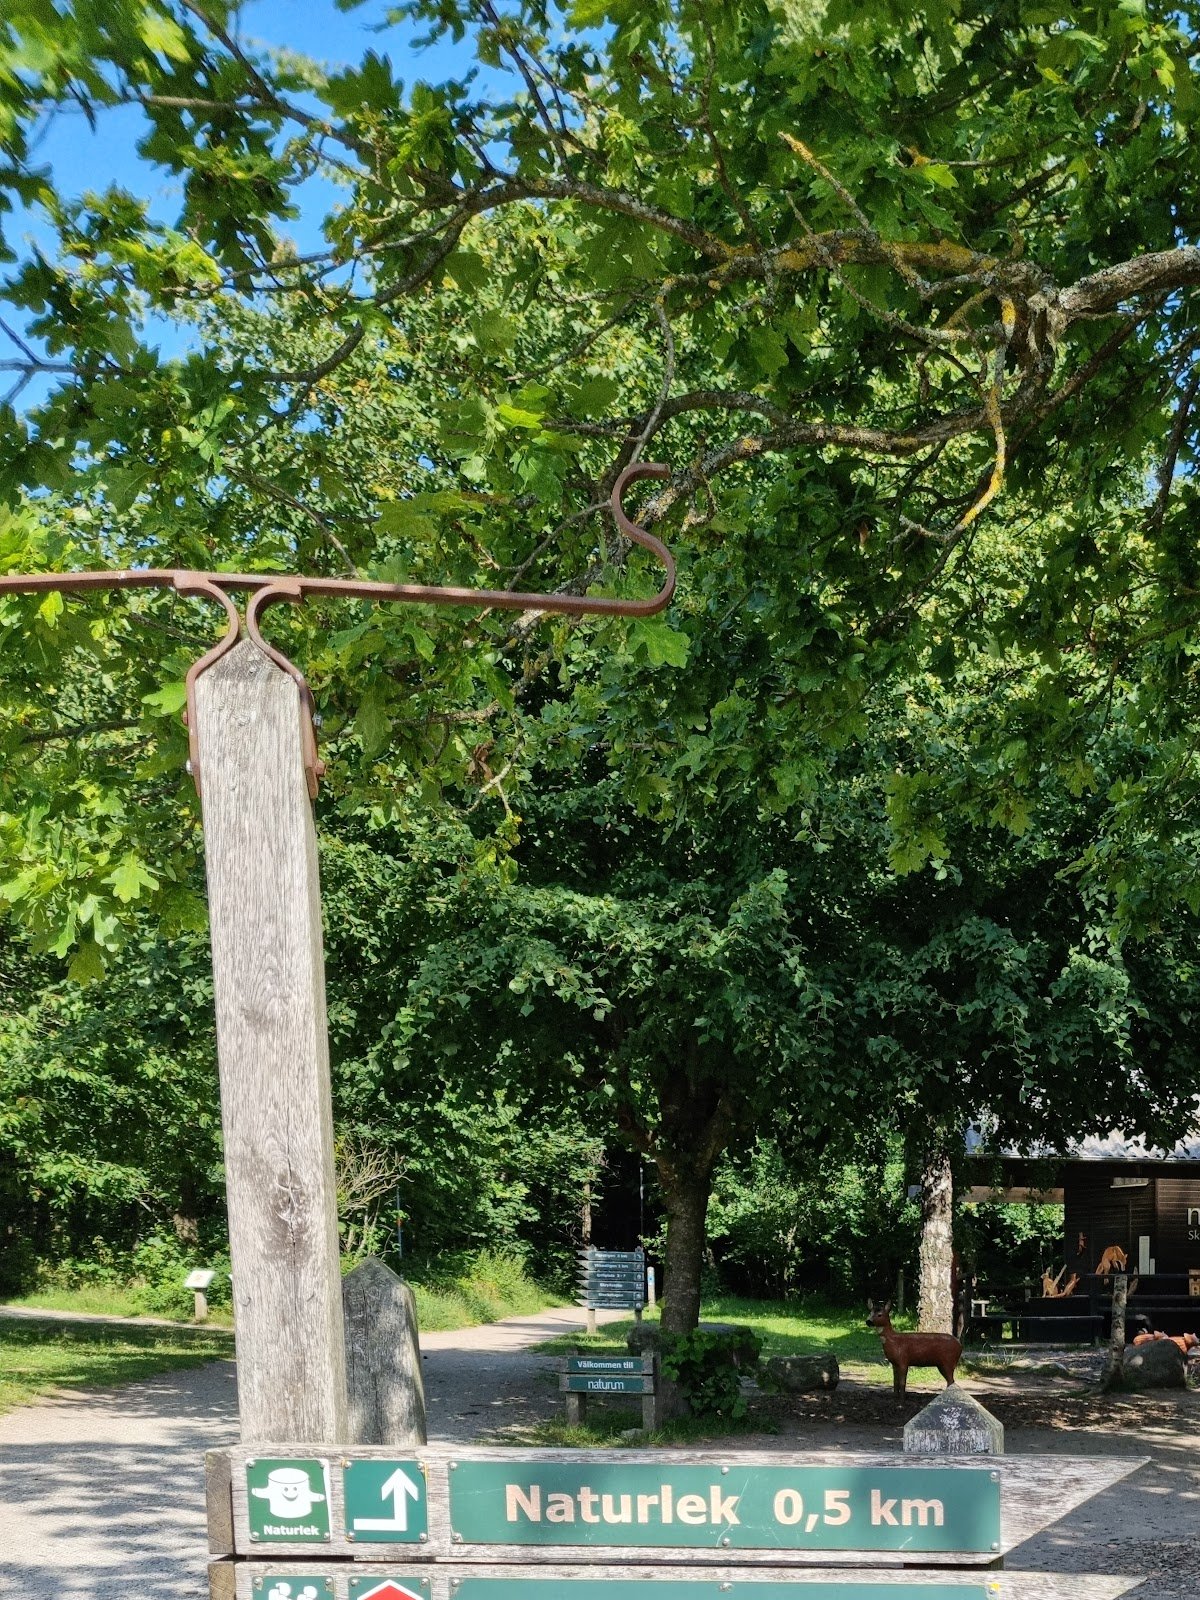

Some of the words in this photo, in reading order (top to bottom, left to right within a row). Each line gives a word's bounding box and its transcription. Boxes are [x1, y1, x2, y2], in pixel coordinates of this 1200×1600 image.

[577, 1361, 621, 1369] Välkommen
[588, 1379, 624, 1390] naturum
[506, 1485, 740, 1528] Naturlek
[774, 1489, 851, 1532] 0,5
[871, 1490, 943, 1526] km
[264, 1525, 319, 1536] Naturlek
